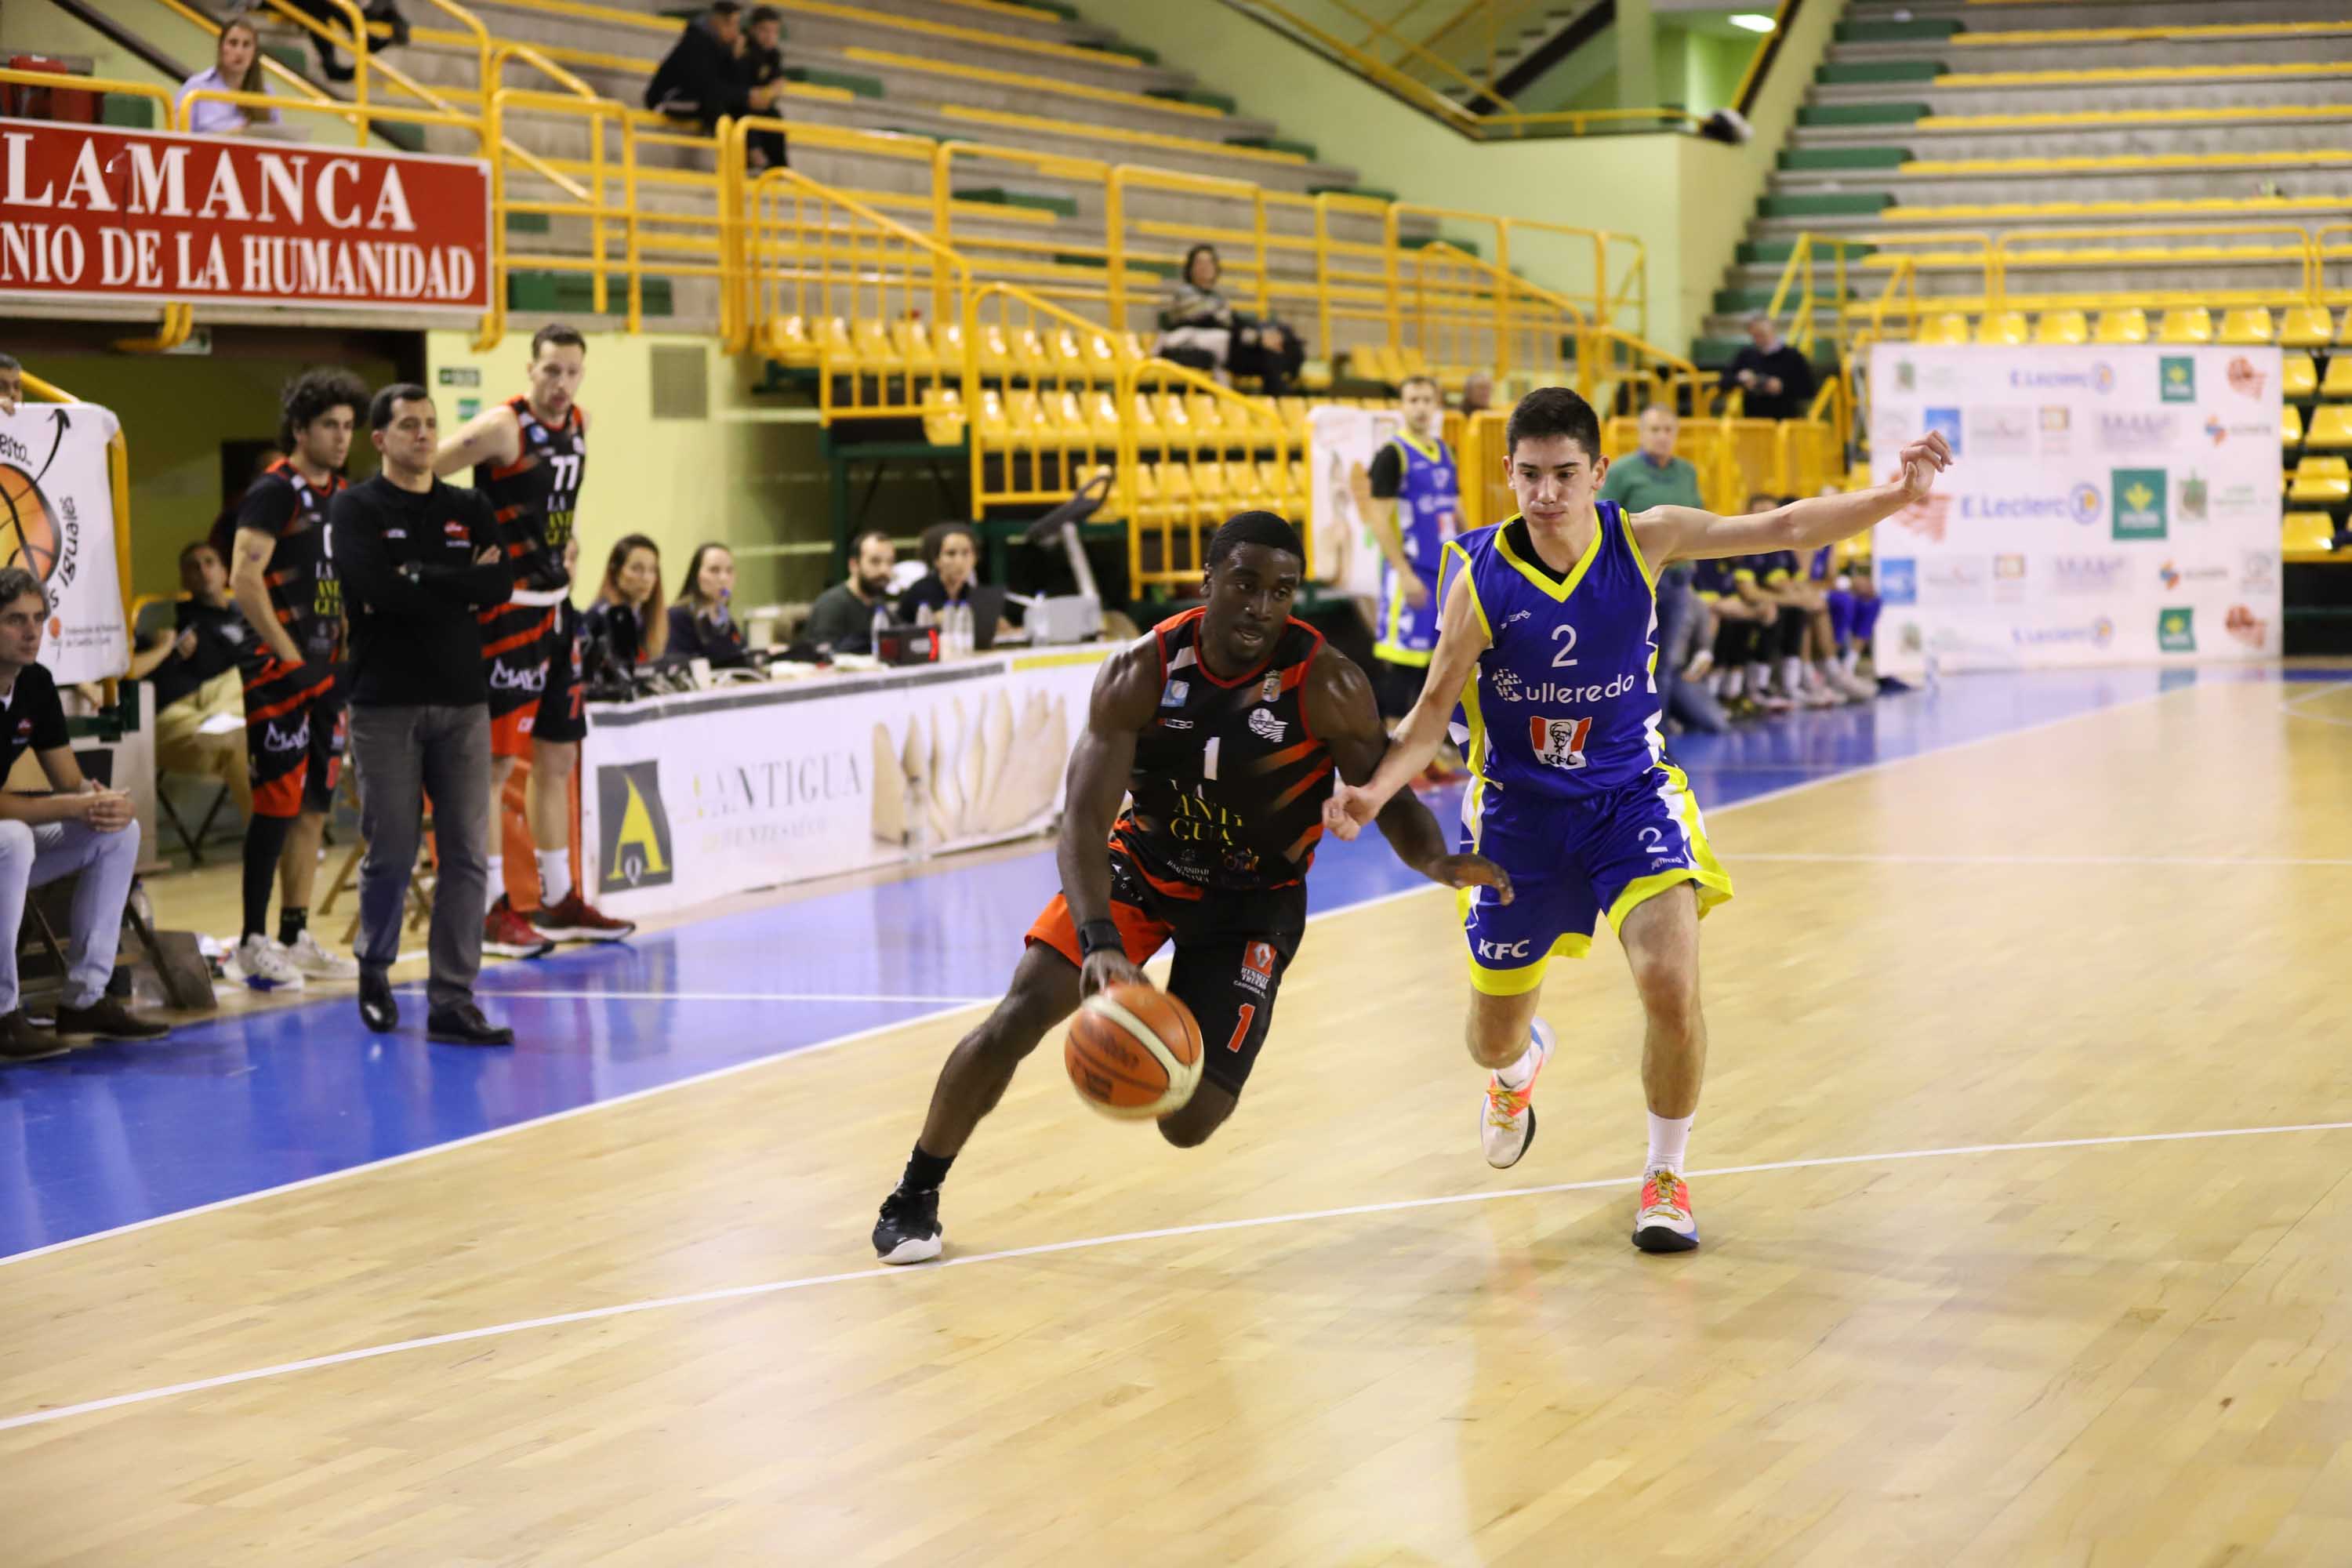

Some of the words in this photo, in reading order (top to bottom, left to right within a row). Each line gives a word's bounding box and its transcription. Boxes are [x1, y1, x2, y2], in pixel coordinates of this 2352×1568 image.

[2, 131, 417, 232] LAMANCA
[0, 220, 85, 285] NIO
[98, 226, 164, 289] DE
[174, 230, 231, 291] LA
[240, 234, 477, 301] HUMANIDAD
[550, 454, 580, 492] 77
[1551, 624, 1578, 668] 2
[1203, 736, 1221, 782] 1
[1543, 753, 1578, 767] KFC
[1638, 826, 1669, 853] 2
[1477, 938, 1531, 960] KFC
[1226, 1003, 1256, 1054] 1
